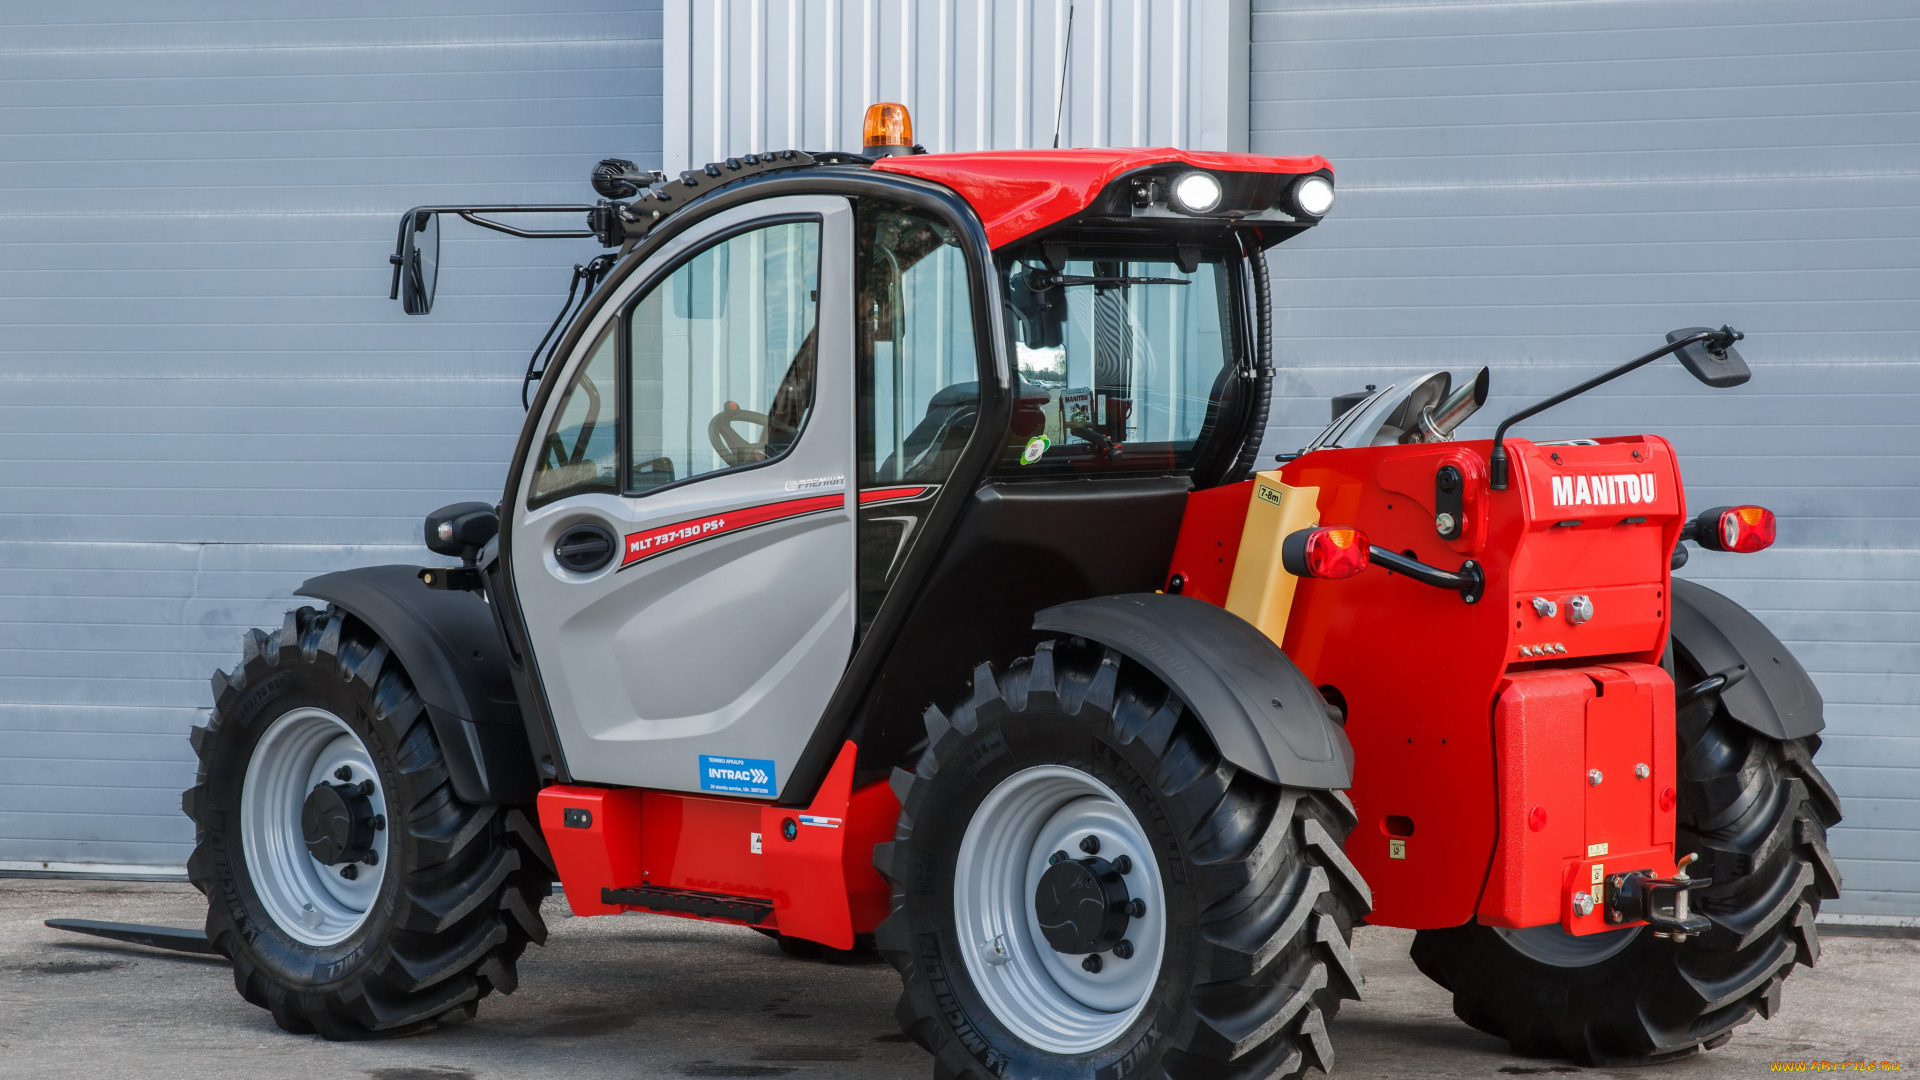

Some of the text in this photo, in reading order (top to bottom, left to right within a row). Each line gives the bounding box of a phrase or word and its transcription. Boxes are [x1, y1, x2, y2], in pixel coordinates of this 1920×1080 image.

[1065, 394, 1088, 403] MANITOU
[798, 475, 844, 489] PREMIUM
[1261, 487, 1279, 503] 7-8m
[1552, 473, 1655, 506] MANITOU
[631, 519, 725, 552] MLT 737-130 PS+
[708, 767, 750, 781] INTRAC
[327, 943, 367, 979] XMCL
[917, 934, 988, 1056] MICHELIN
[1111, 1021, 1163, 1080] XMCL
